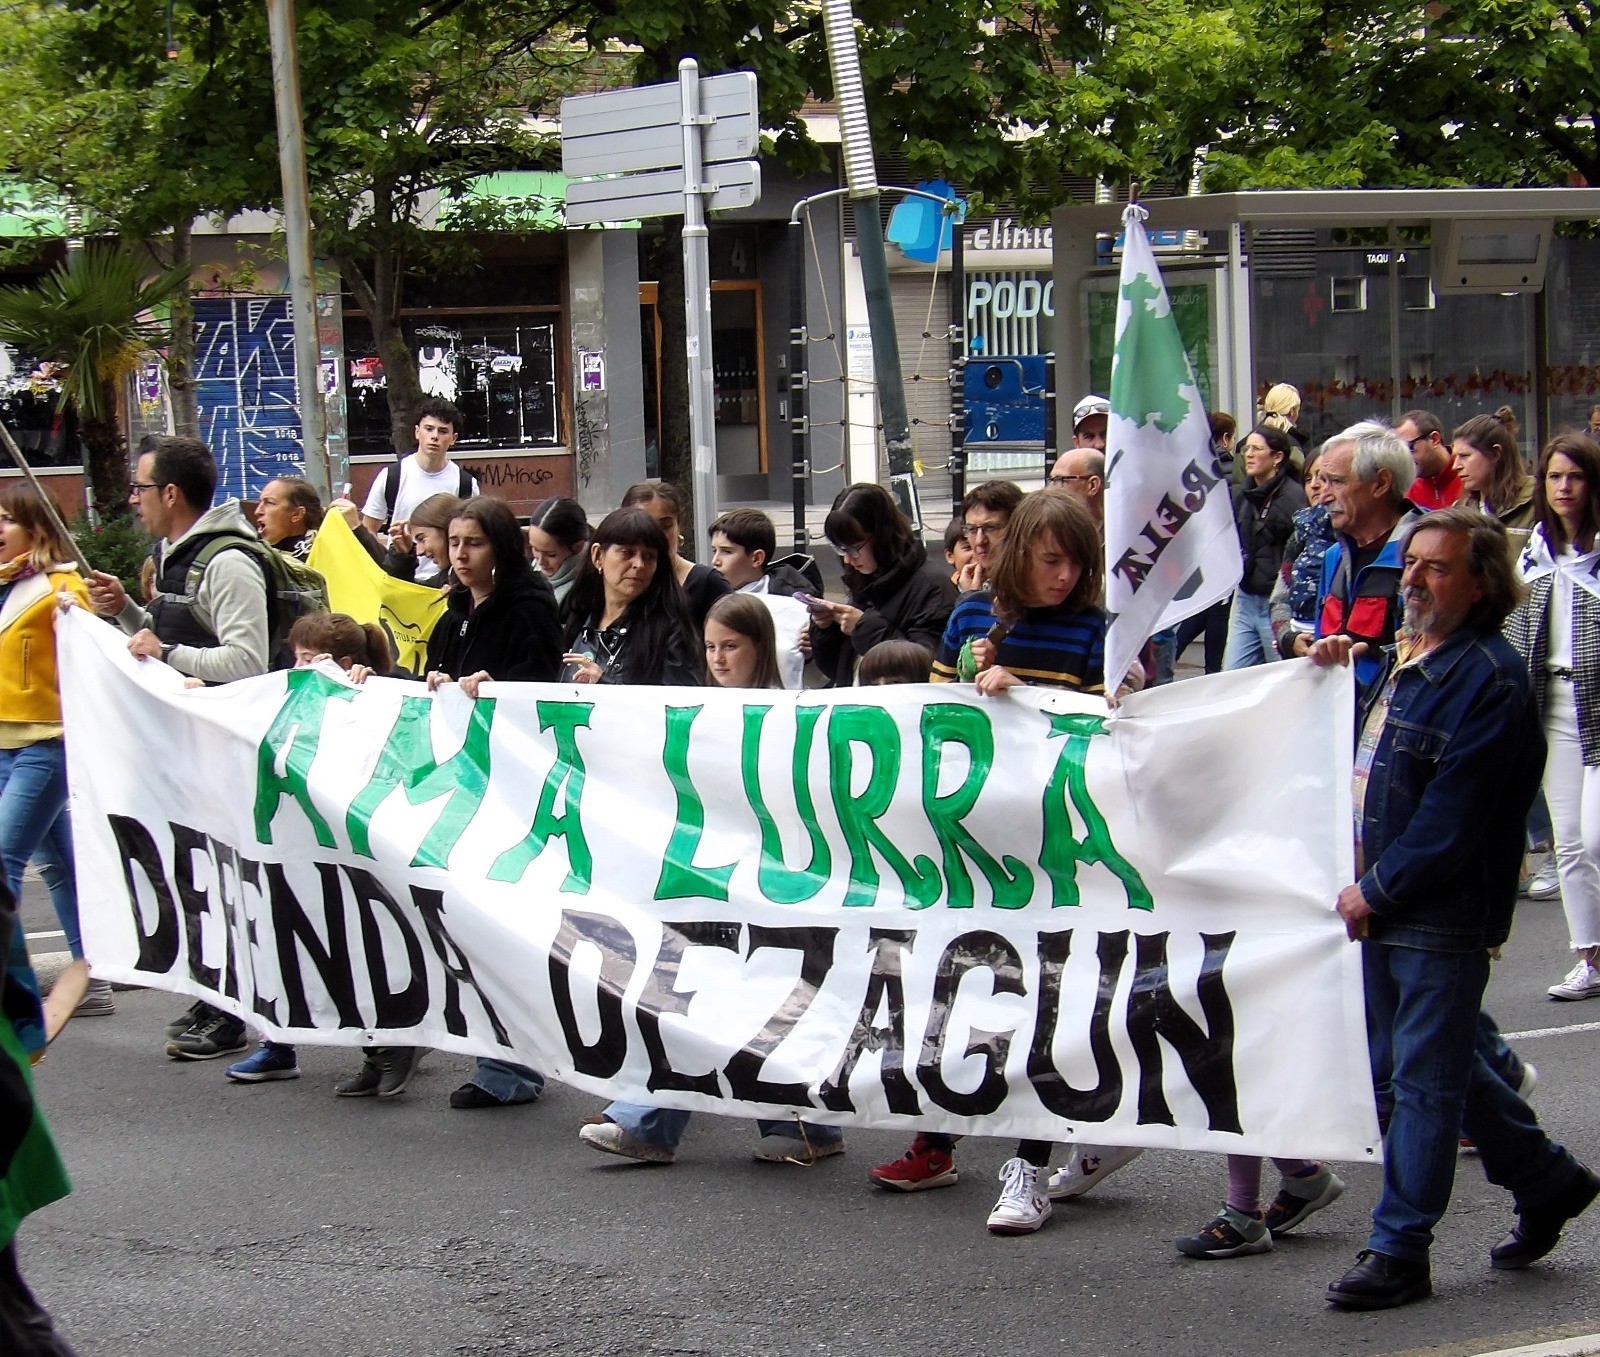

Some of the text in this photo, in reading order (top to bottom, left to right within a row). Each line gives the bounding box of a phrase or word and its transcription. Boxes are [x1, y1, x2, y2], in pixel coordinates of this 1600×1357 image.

[731, 239, 748, 274] 4
[254, 669, 1154, 912] AMA LURRA
[107, 814, 1244, 1135] DEFENDA DEZAGUN
